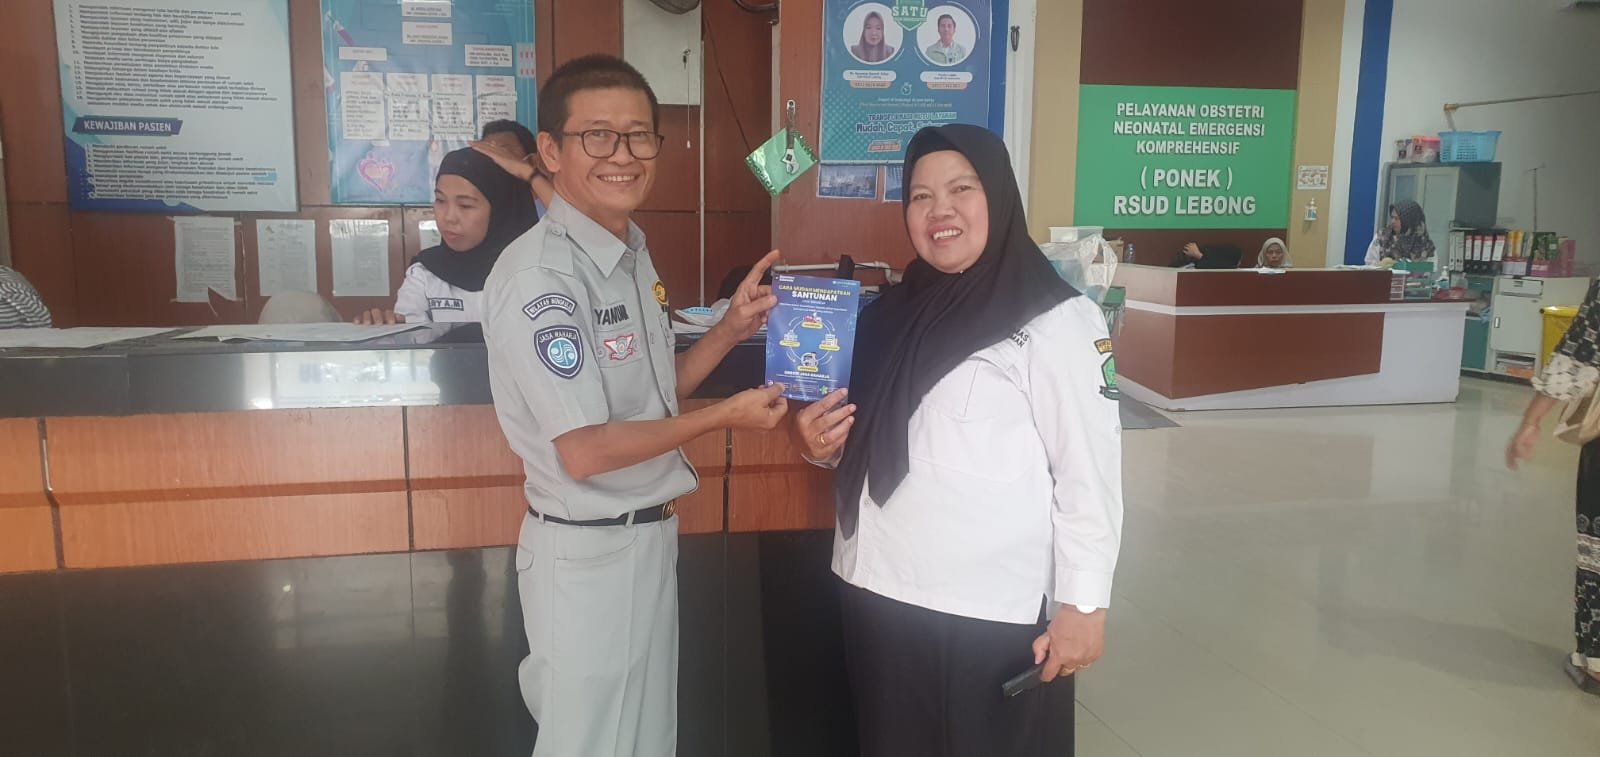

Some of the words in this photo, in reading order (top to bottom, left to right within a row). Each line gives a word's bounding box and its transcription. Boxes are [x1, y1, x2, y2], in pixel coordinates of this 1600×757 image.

[892, 6, 928, 17] SATU
[1117, 102, 1196, 118] PELAYANAN
[1200, 104, 1265, 118] OBSTETRI
[84, 120, 136, 131] KEWAJIBAN
[138, 122, 171, 132] PASIEN
[1113, 121, 1185, 135] NEONATAL
[1189, 122, 1265, 137] EMERGENSI
[1136, 140, 1240, 155] KOMPREHENSIF
[1153, 168, 1221, 188] PONEK
[1113, 195, 1169, 215] RSUD
[1175, 196, 1256, 215] LEBONG
[792, 290, 838, 301] SANTUNAN
[539, 332, 554, 343] JASA
